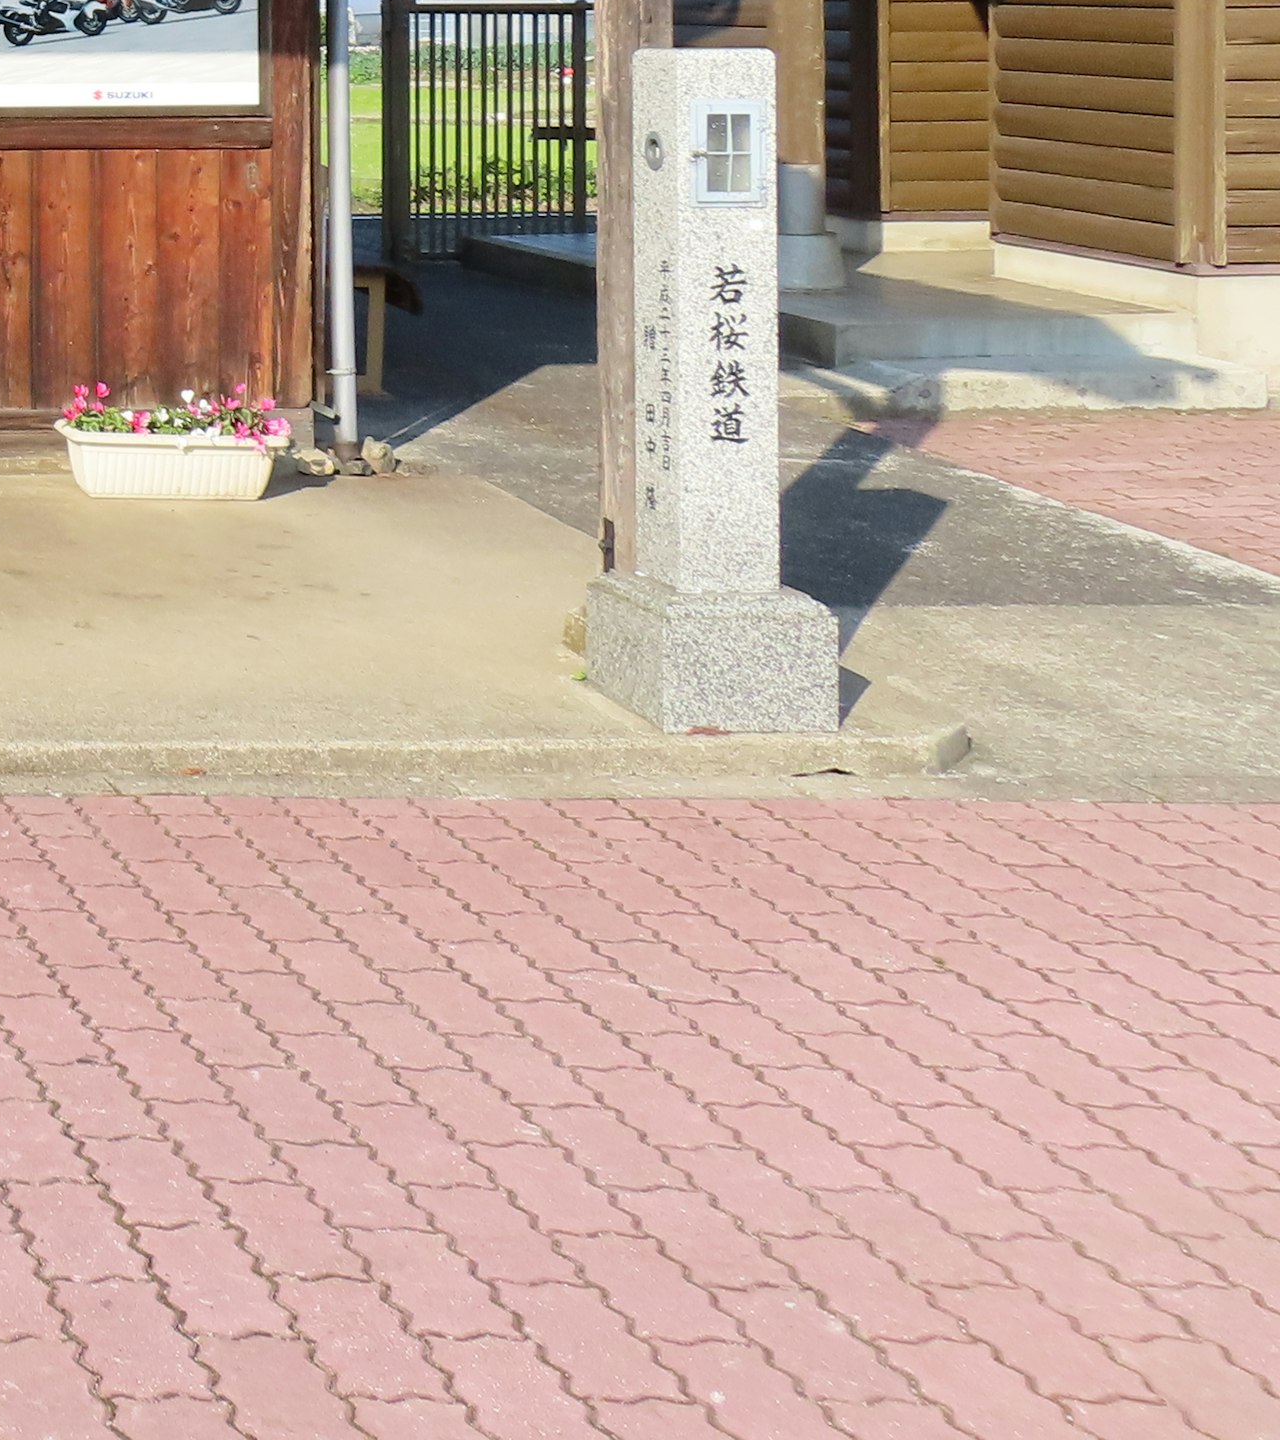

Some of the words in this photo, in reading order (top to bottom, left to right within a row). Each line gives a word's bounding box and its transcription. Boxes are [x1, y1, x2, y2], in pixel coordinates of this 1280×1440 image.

[106, 91, 154, 100] SUZUKI
[708, 262, 752, 445] 若桜鉄道
